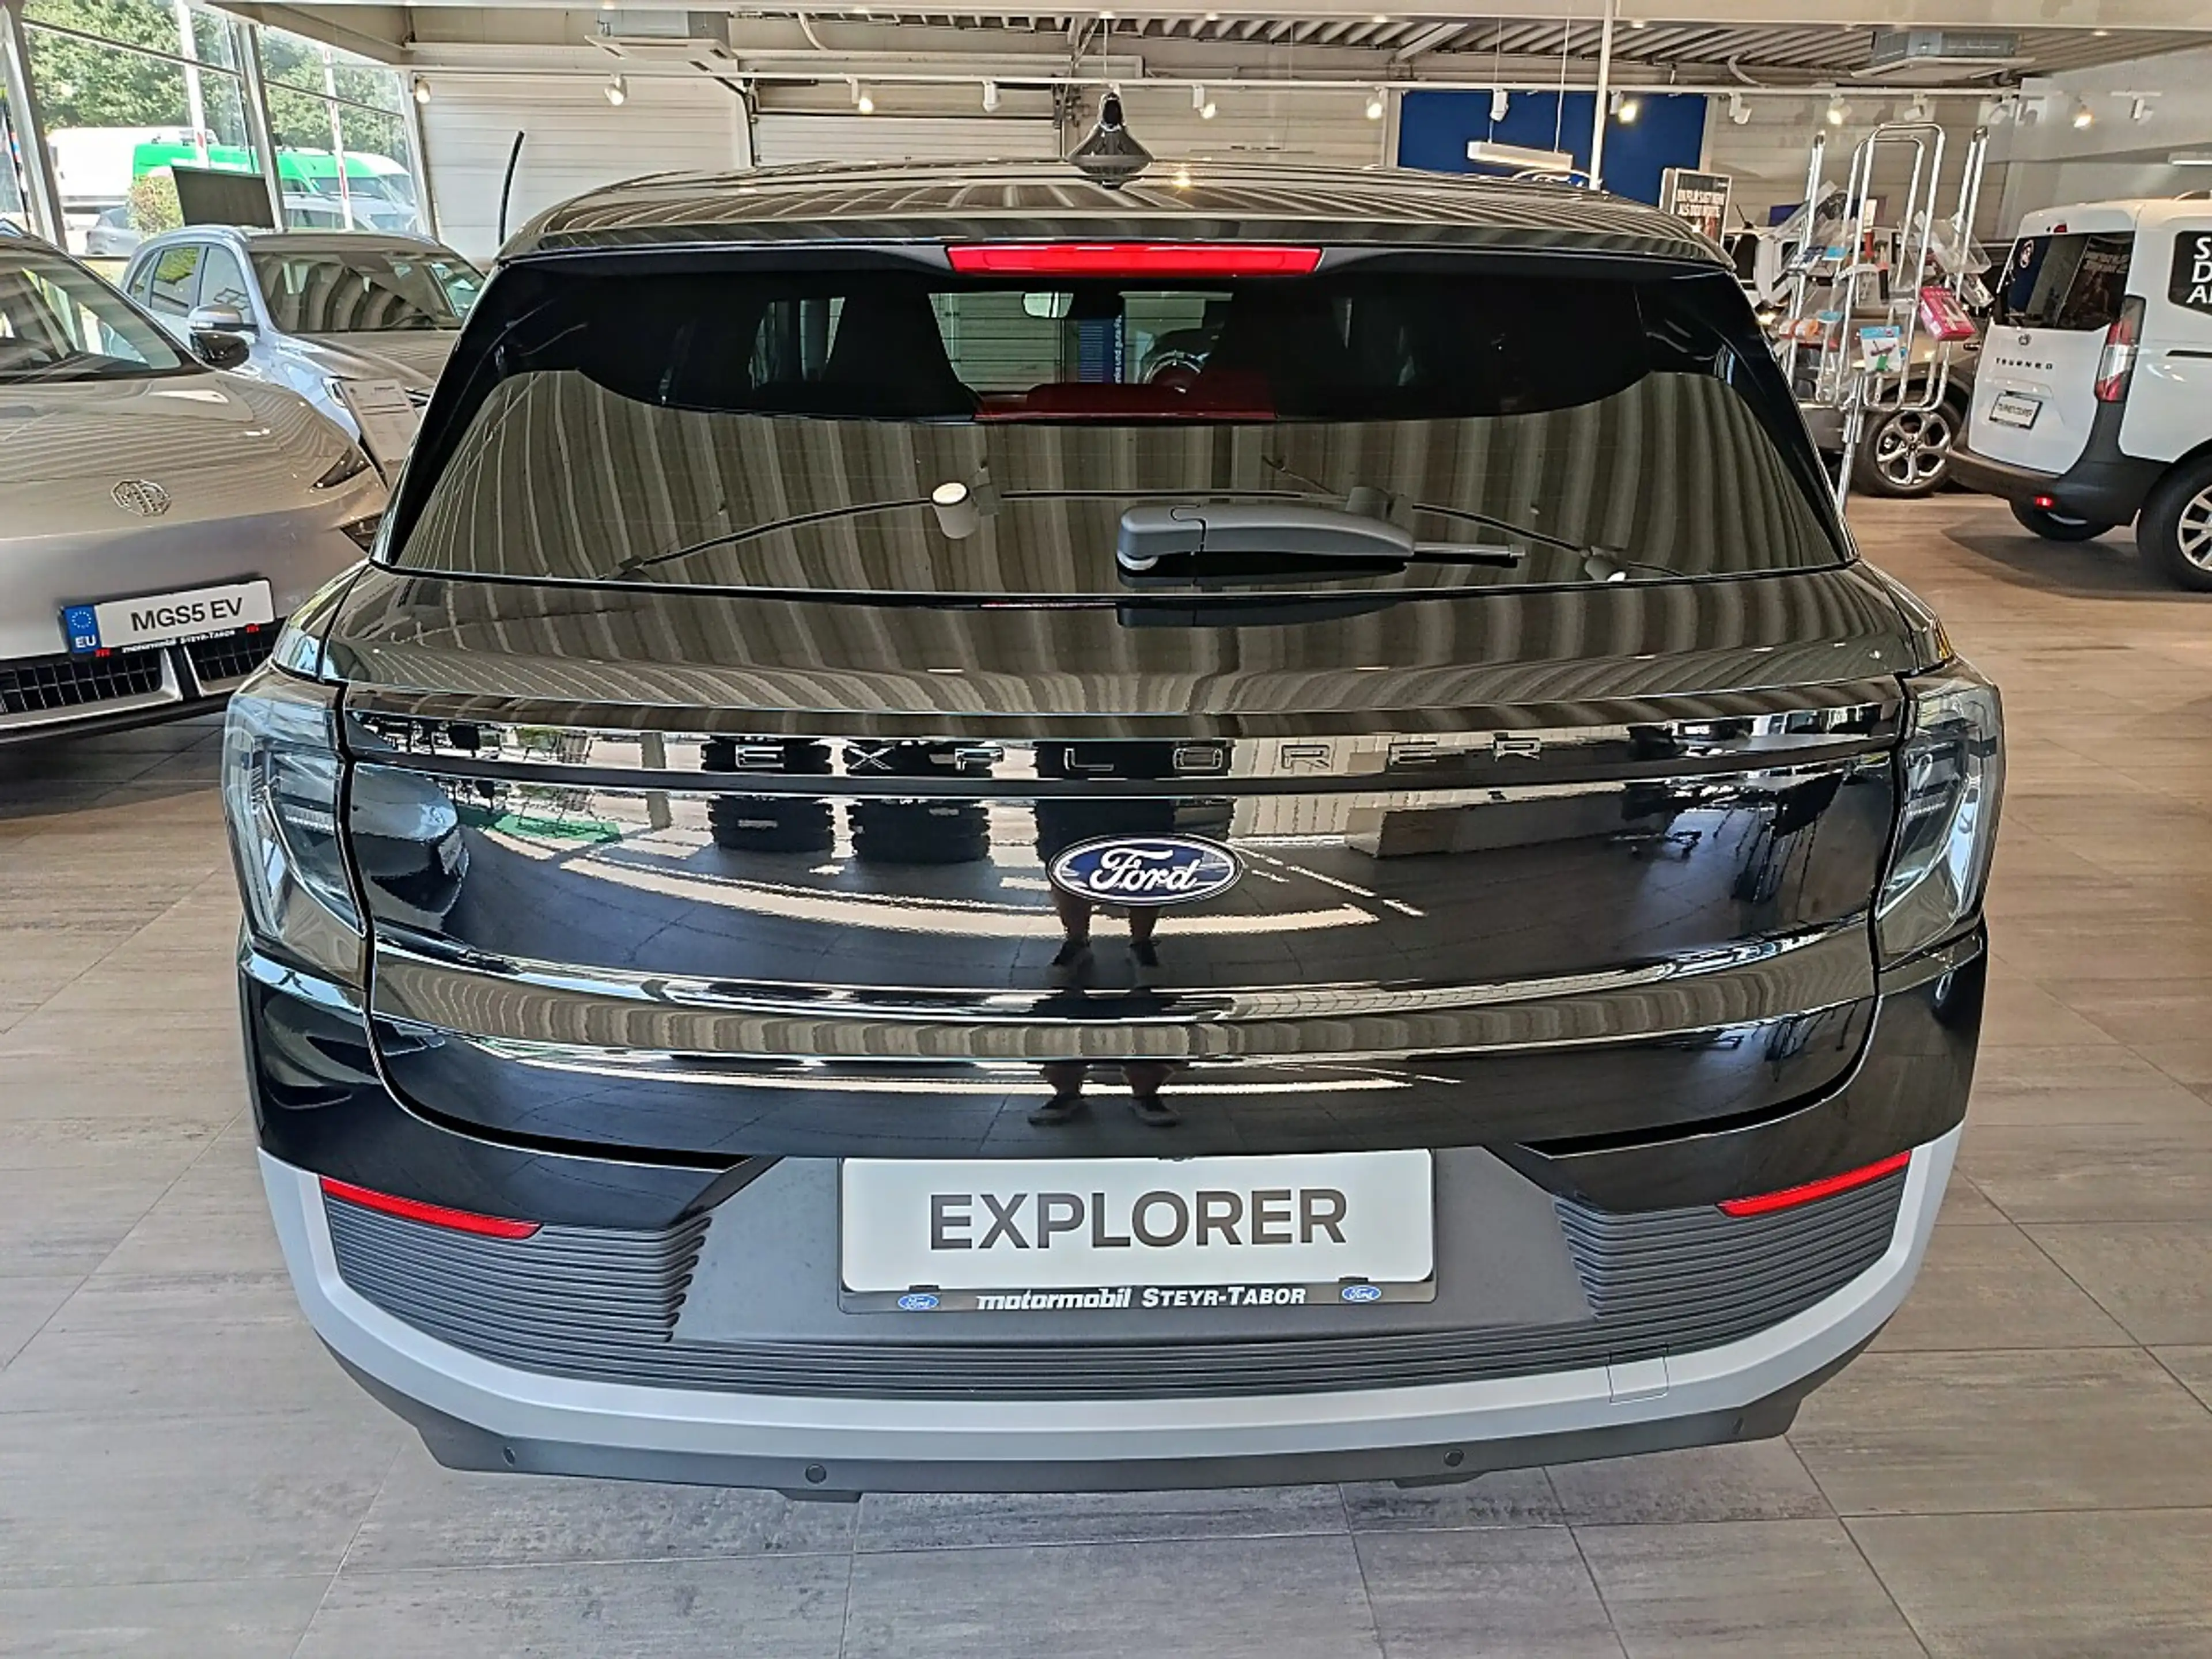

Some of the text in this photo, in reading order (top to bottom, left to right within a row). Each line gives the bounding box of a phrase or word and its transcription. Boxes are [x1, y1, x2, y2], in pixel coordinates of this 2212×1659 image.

[130, 597, 243, 631] MGS5 EV
[75, 635, 97, 648] EU
[735, 737, 1541, 771] EXPLORER
[1089, 847, 1203, 892] Ford
[930, 1188, 1347, 1250] EXPLORER
[976, 1286, 1306, 1310] motormobil STEYR-TABOR
